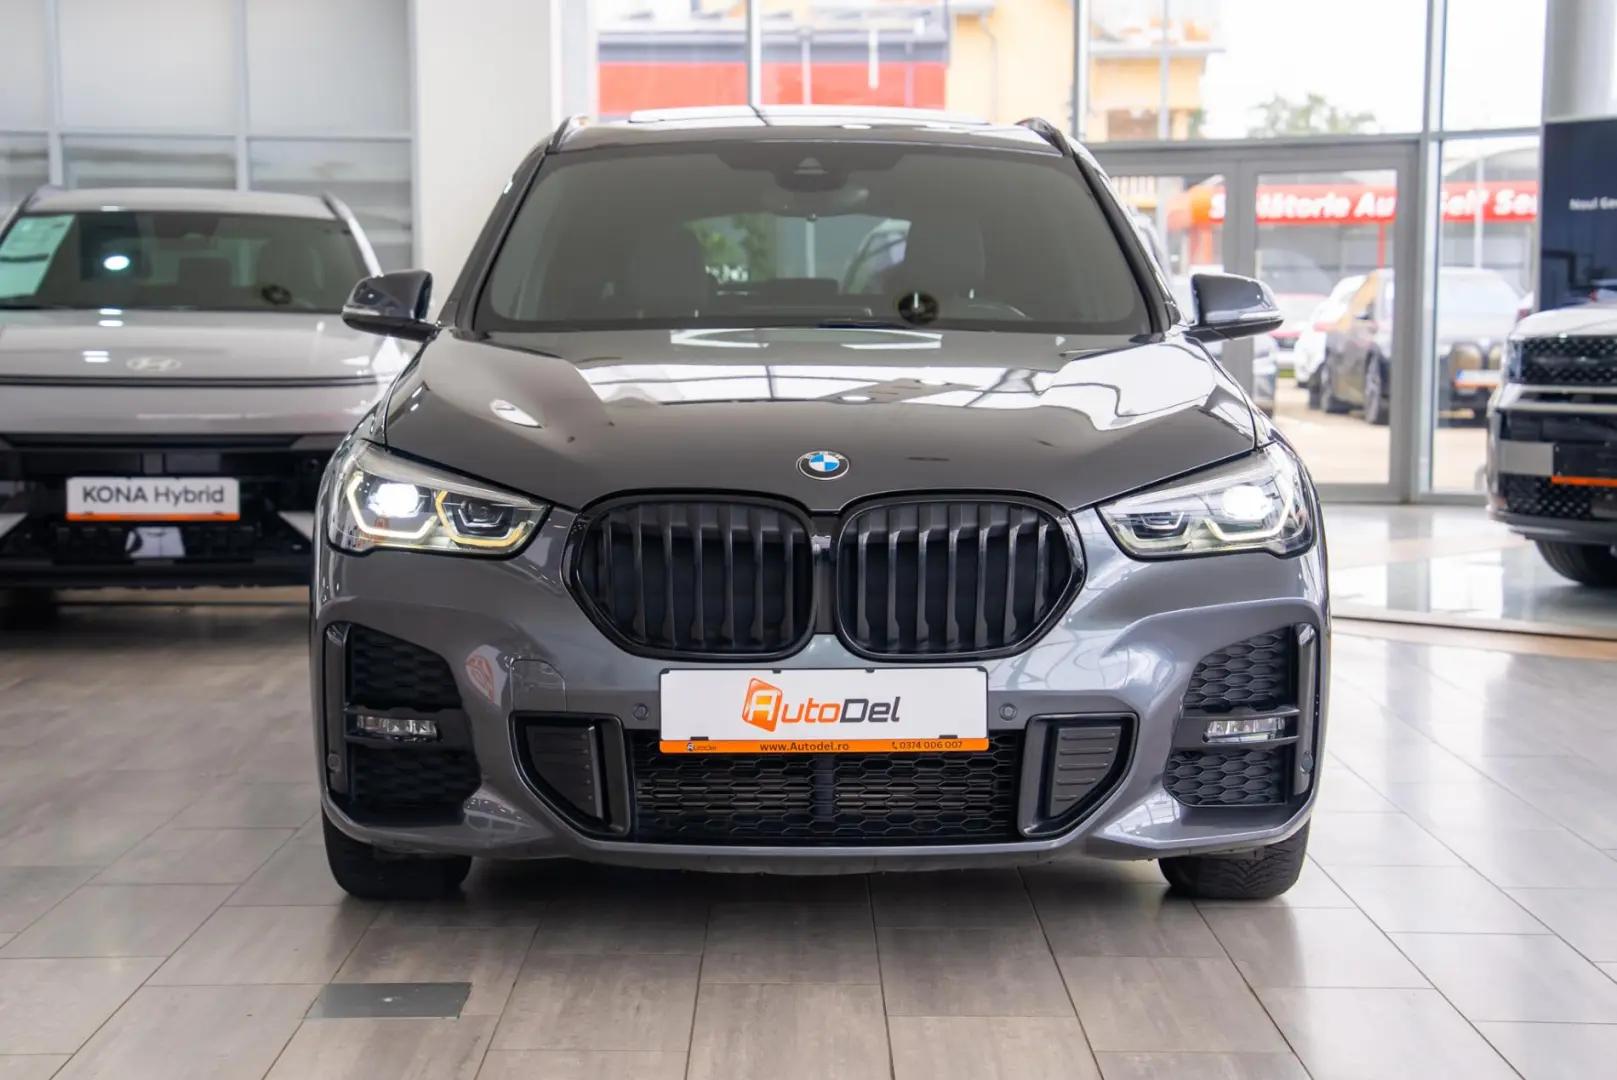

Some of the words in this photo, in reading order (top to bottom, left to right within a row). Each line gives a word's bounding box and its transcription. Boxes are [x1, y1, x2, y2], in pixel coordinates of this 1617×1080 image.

[82, 485, 148, 503] KONA
[154, 484, 225, 507] Hybrid
[746, 688, 901, 724] AutoDel
[759, 741, 850, 752] www.Autodel.ro
[900, 740, 921, 750] 0374
[924, 740, 943, 749] 006
[945, 740, 963, 749] 007
